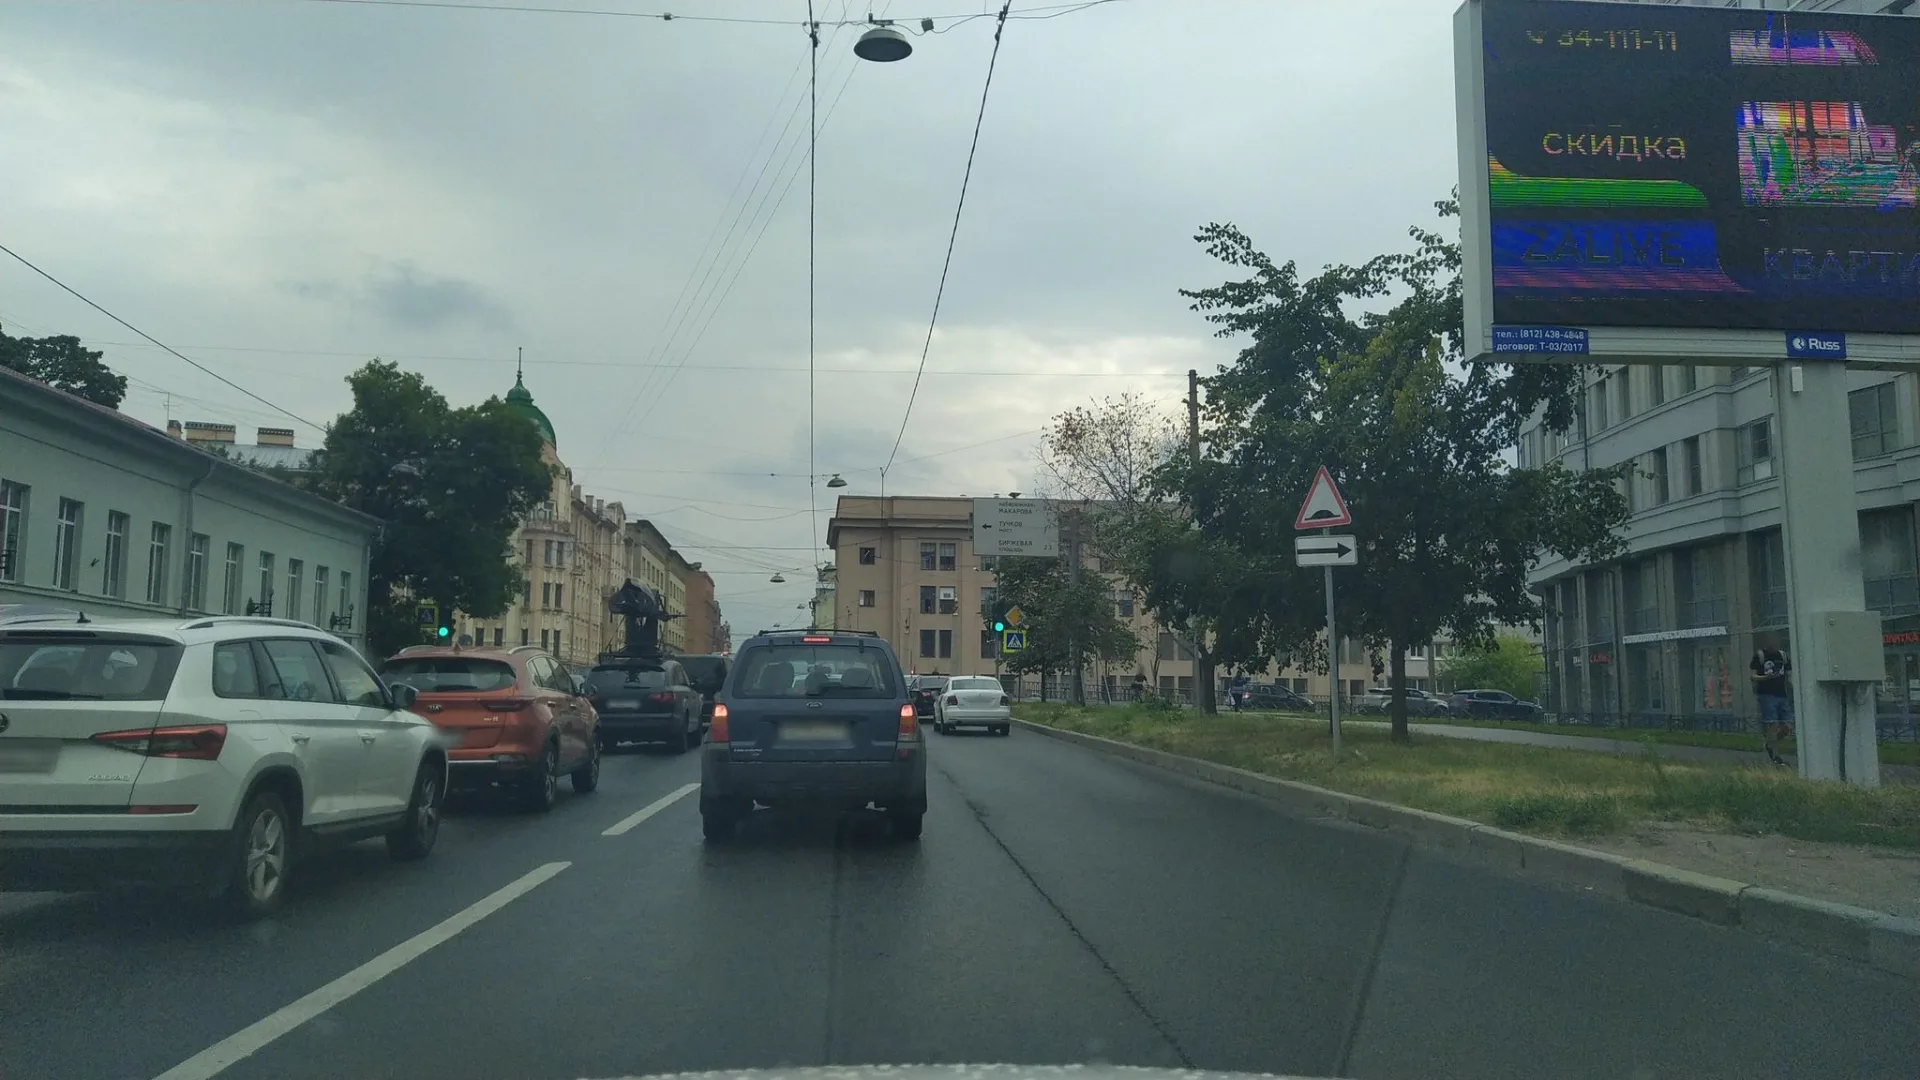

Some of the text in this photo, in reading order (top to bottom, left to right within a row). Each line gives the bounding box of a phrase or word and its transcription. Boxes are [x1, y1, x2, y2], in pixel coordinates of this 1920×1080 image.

[1522, 229, 1685, 265] ZALIVE
[1520, 329, 1543, 339] (812)
[1544, 330, 1584, 340] 438-4848
[1496, 343, 1538, 352] договор:
[1808, 338, 1841, 350] Russ
[998, 520, 1023, 528] ТУЧКОВ
